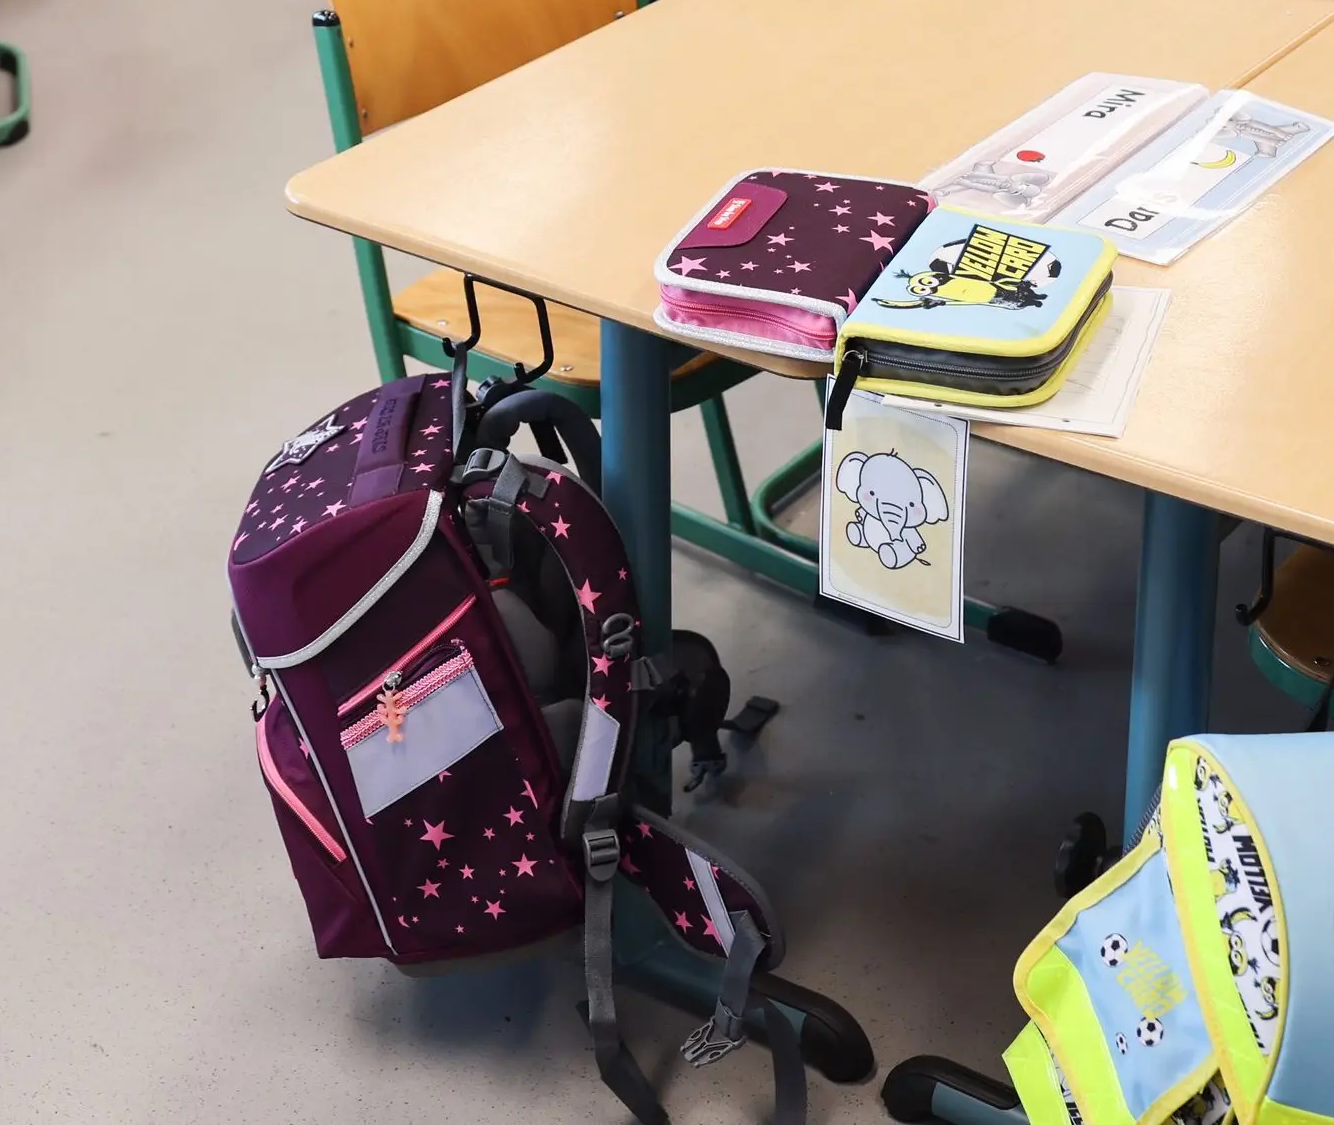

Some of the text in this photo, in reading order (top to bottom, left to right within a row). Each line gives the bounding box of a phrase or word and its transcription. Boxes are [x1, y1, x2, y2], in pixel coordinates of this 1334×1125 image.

[1082, 89, 1146, 119] Mira
[954, 226, 1009, 281] YELLOW
[996, 235, 1047, 280] CARD
[1231, 835, 1274, 913] YELLOW
